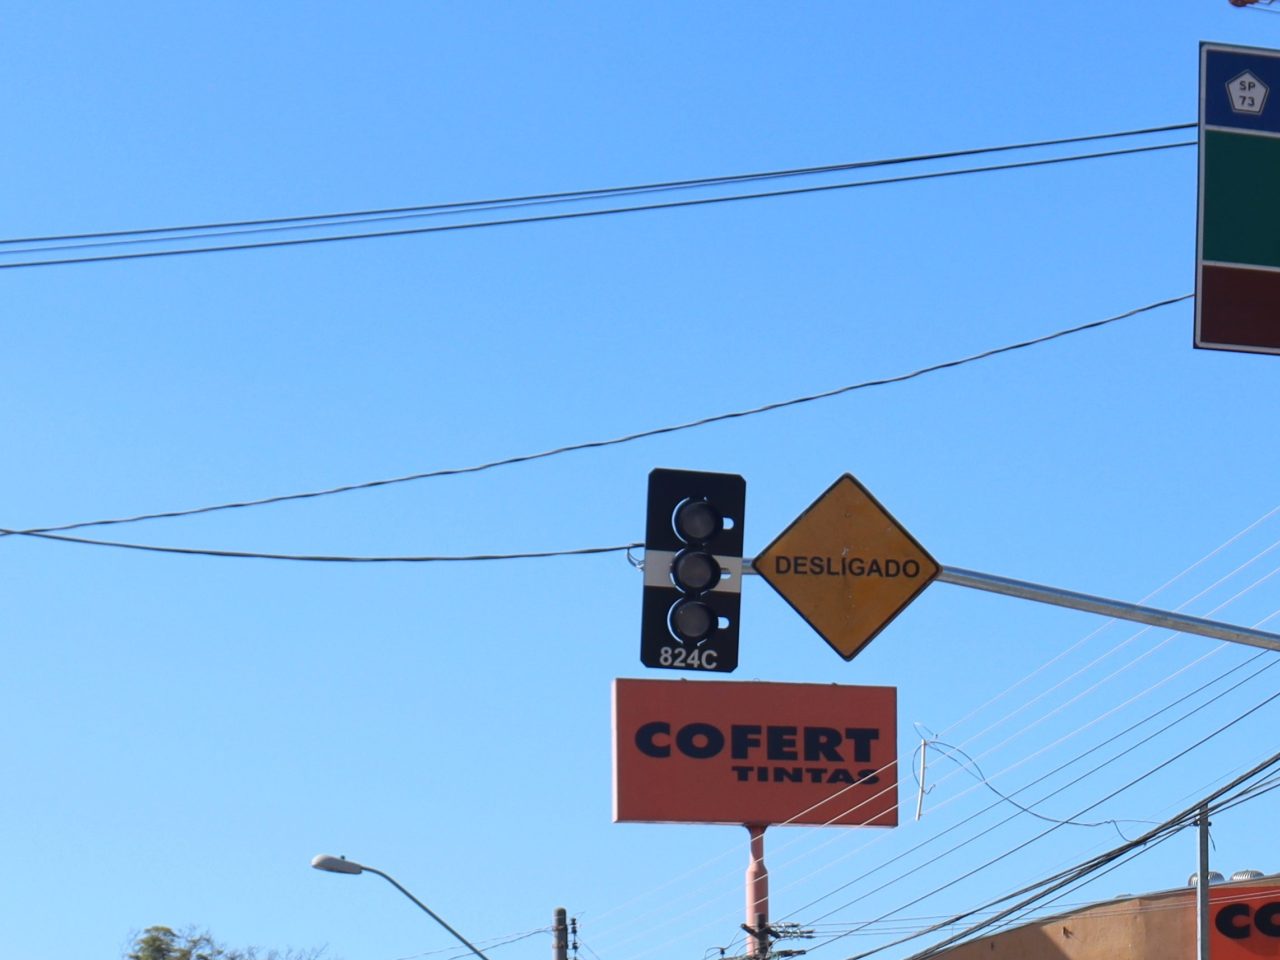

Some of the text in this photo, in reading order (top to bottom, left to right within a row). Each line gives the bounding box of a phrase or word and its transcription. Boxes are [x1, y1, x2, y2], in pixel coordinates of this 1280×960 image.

[1239, 80, 1256, 91] SP
[1239, 95, 1255, 107] 73
[774, 555, 920, 578] DESLIGADO
[659, 646, 718, 670] 824C
[634, 721, 880, 763] COFERT
[731, 765, 880, 785] TINTAS
